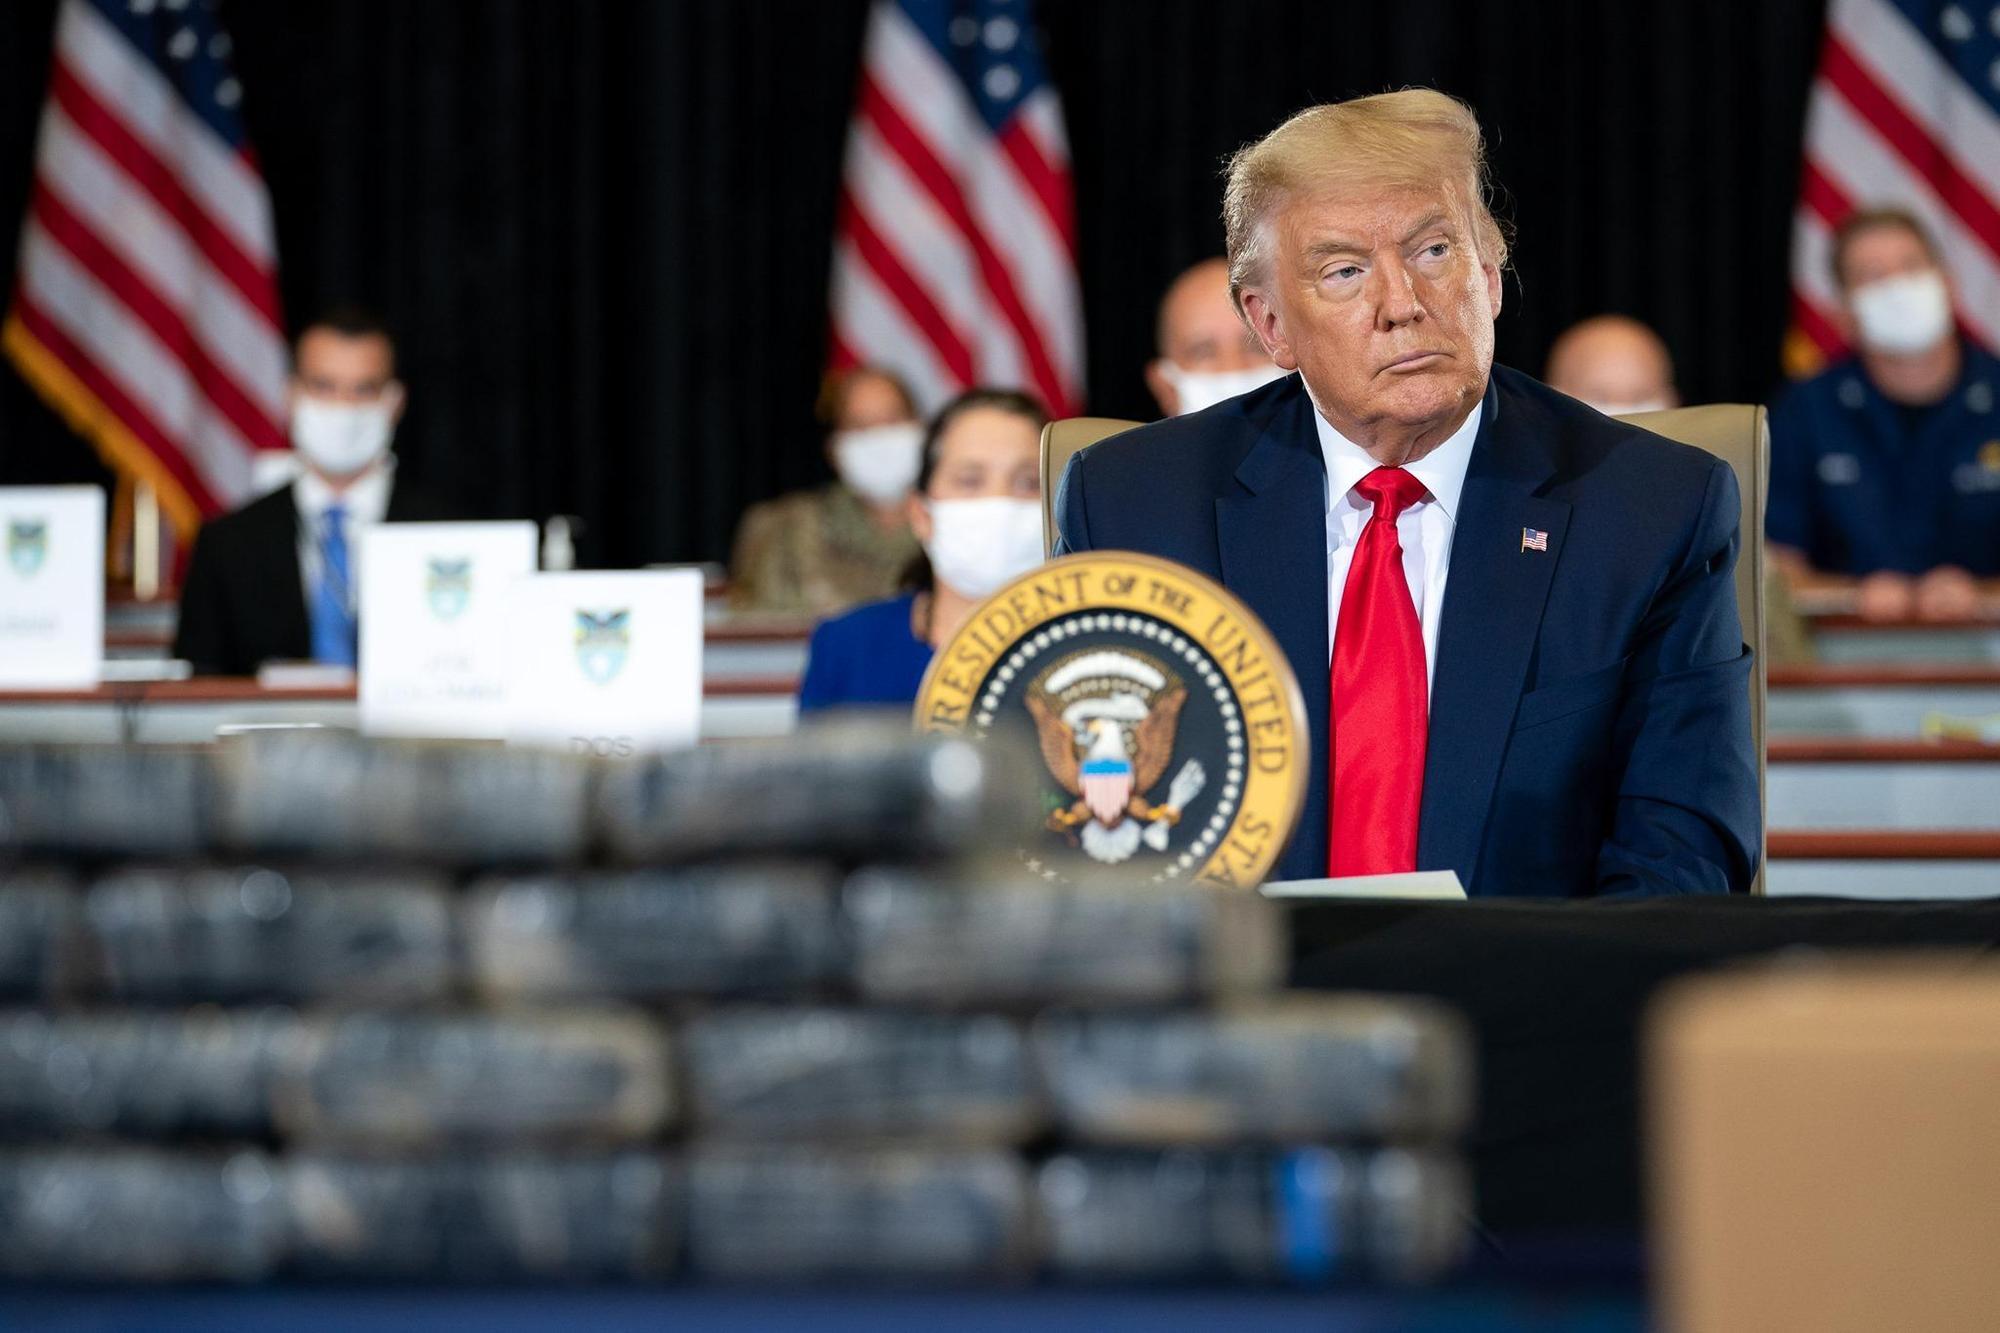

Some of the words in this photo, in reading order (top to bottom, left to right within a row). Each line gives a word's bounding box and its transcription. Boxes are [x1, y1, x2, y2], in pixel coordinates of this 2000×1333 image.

[1103, 572, 1137, 597] OF
[1150, 580, 1195, 618] THE
[931, 571, 1091, 727] RESIDENT
[1205, 613, 1287, 774] UNITED
[1205, 811, 1272, 883] STA
